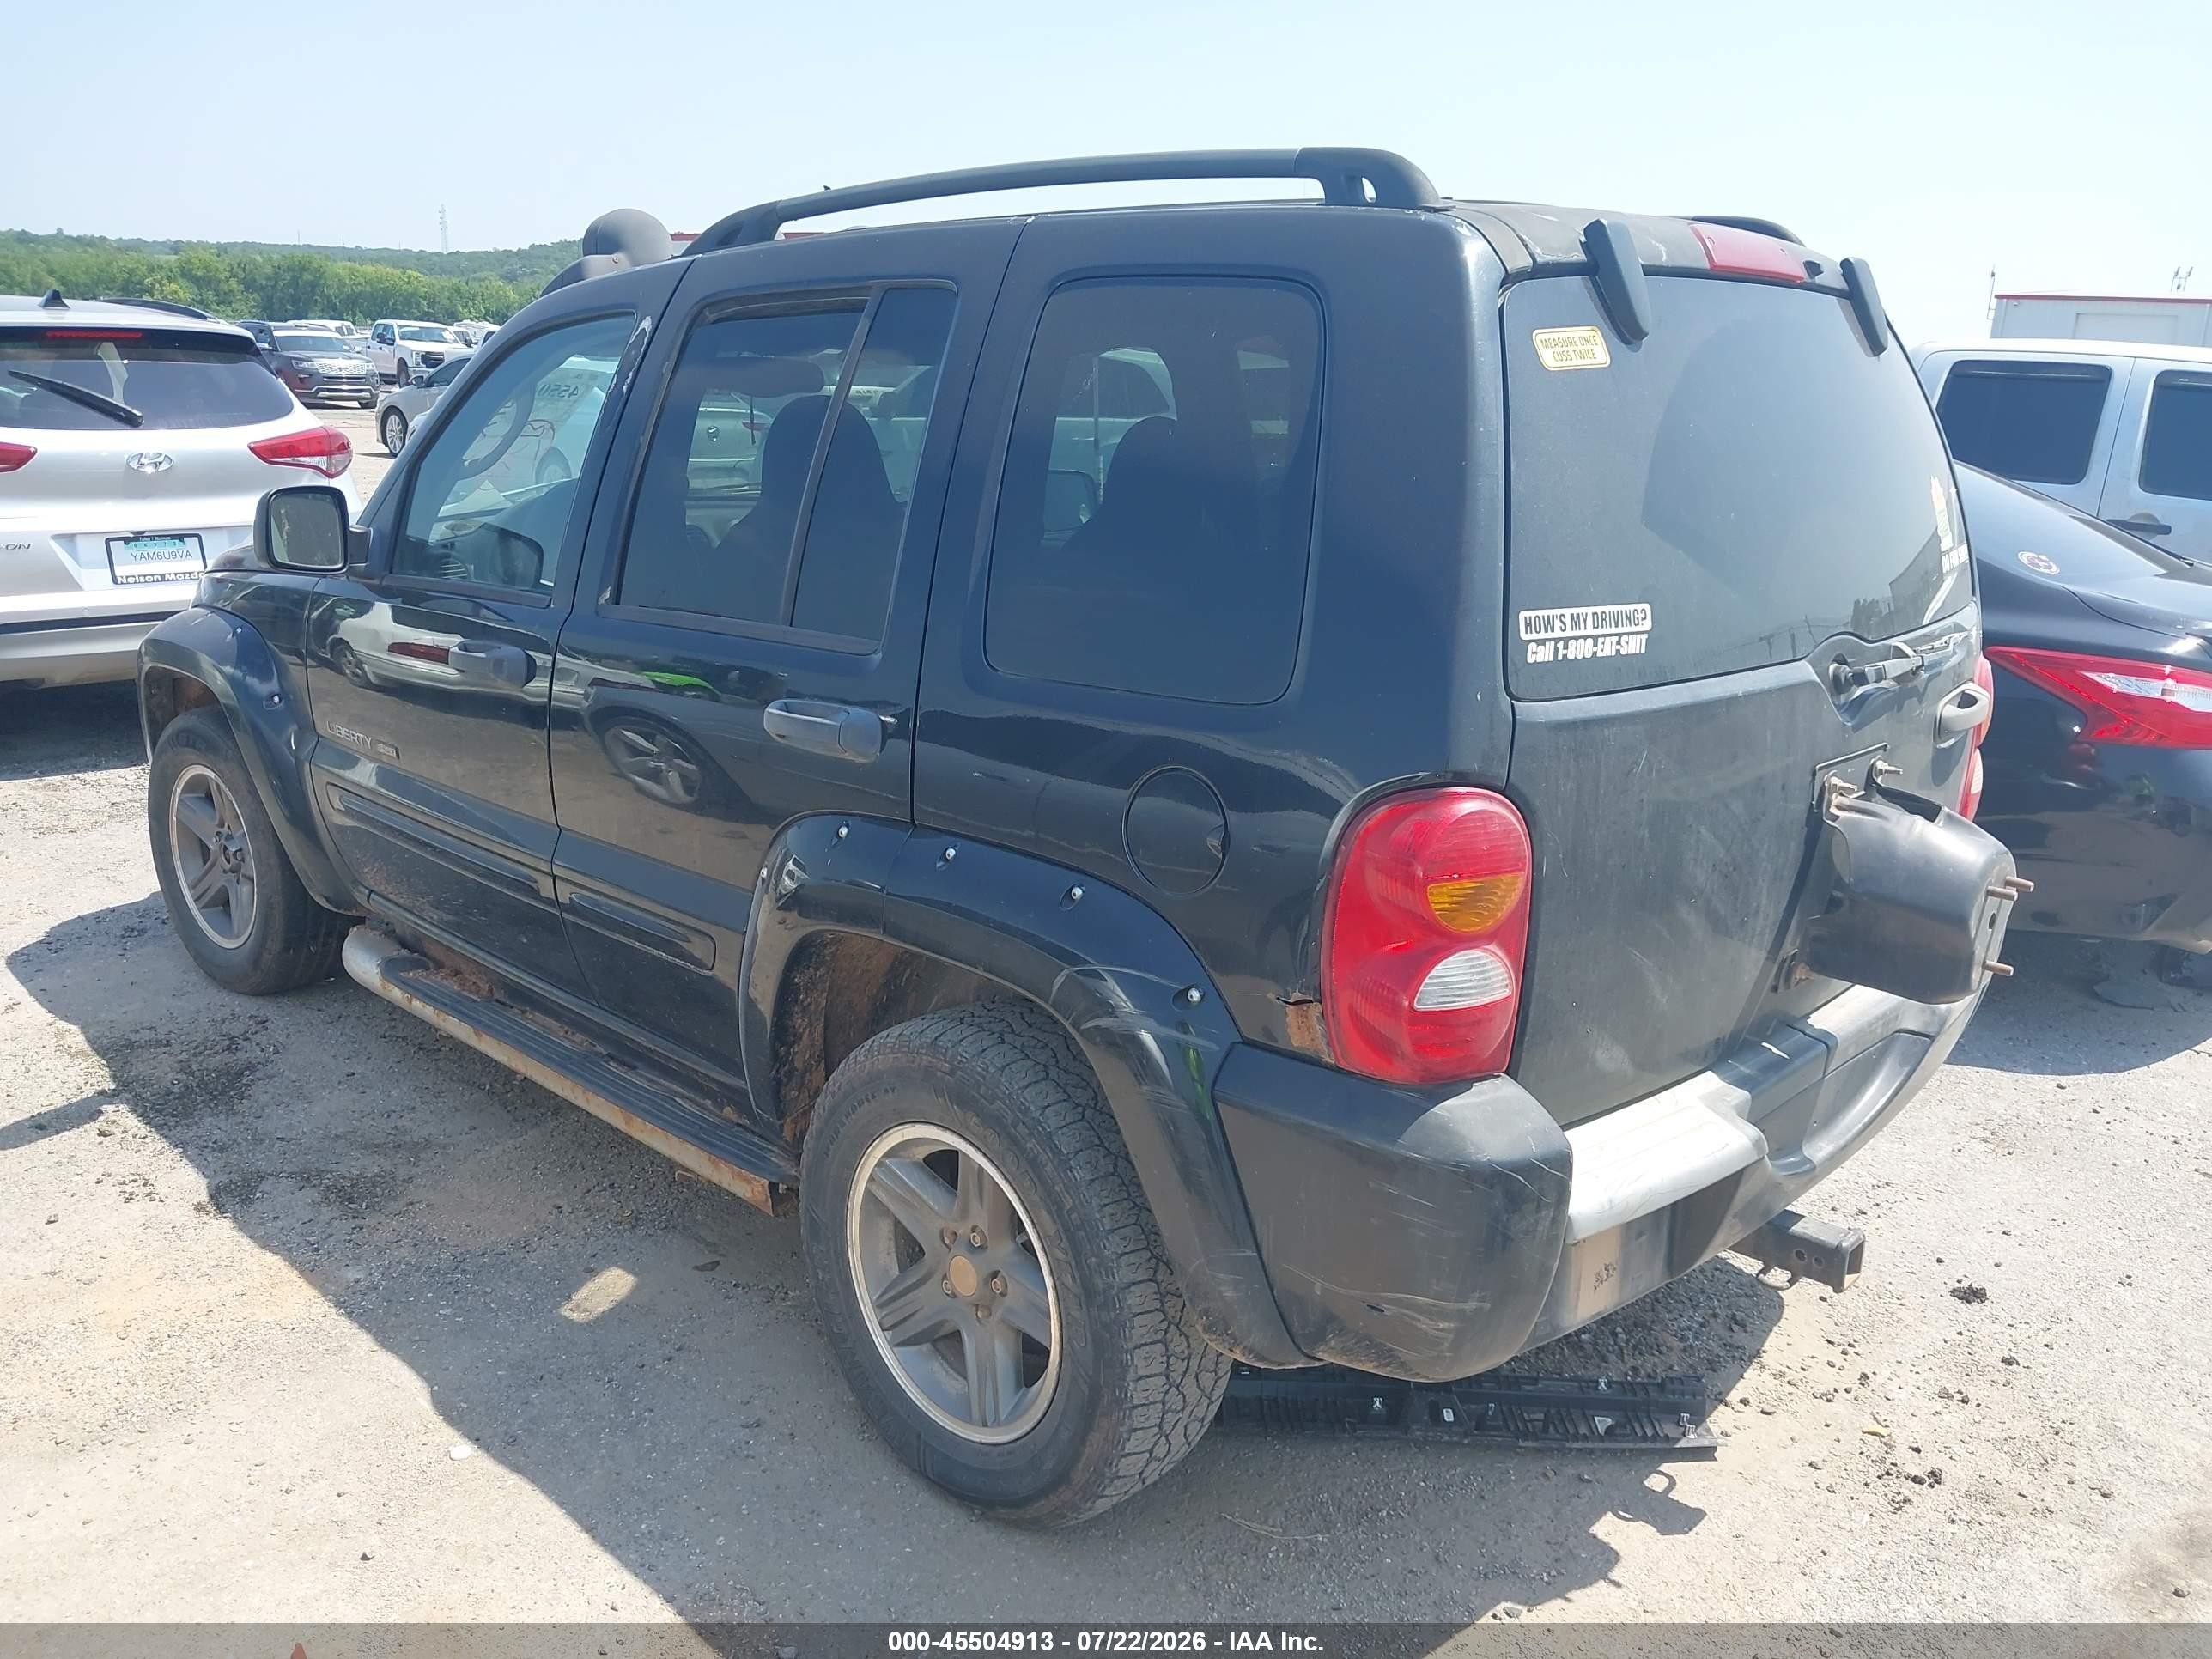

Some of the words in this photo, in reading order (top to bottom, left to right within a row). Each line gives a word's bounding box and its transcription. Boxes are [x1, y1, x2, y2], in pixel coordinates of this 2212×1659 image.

[1540, 336, 1578, 349] MEASURE
[1578, 335, 1599, 346] ONCE
[1552, 349, 1573, 362] CUSS
[1573, 349, 1597, 361] TWICE
[131, 550, 192, 562] YAM6U9VA
[117, 574, 161, 585] Nelson
[1523, 613, 1567, 635] HOW'S
[1570, 612, 1589, 631] MY
[1592, 608, 1647, 630] DRIVING?
[1527, 641, 1555, 664] Call
[1556, 634, 1649, 661] 1-800-EAT-SHIT
[326, 720, 372, 750] LIBERTY
